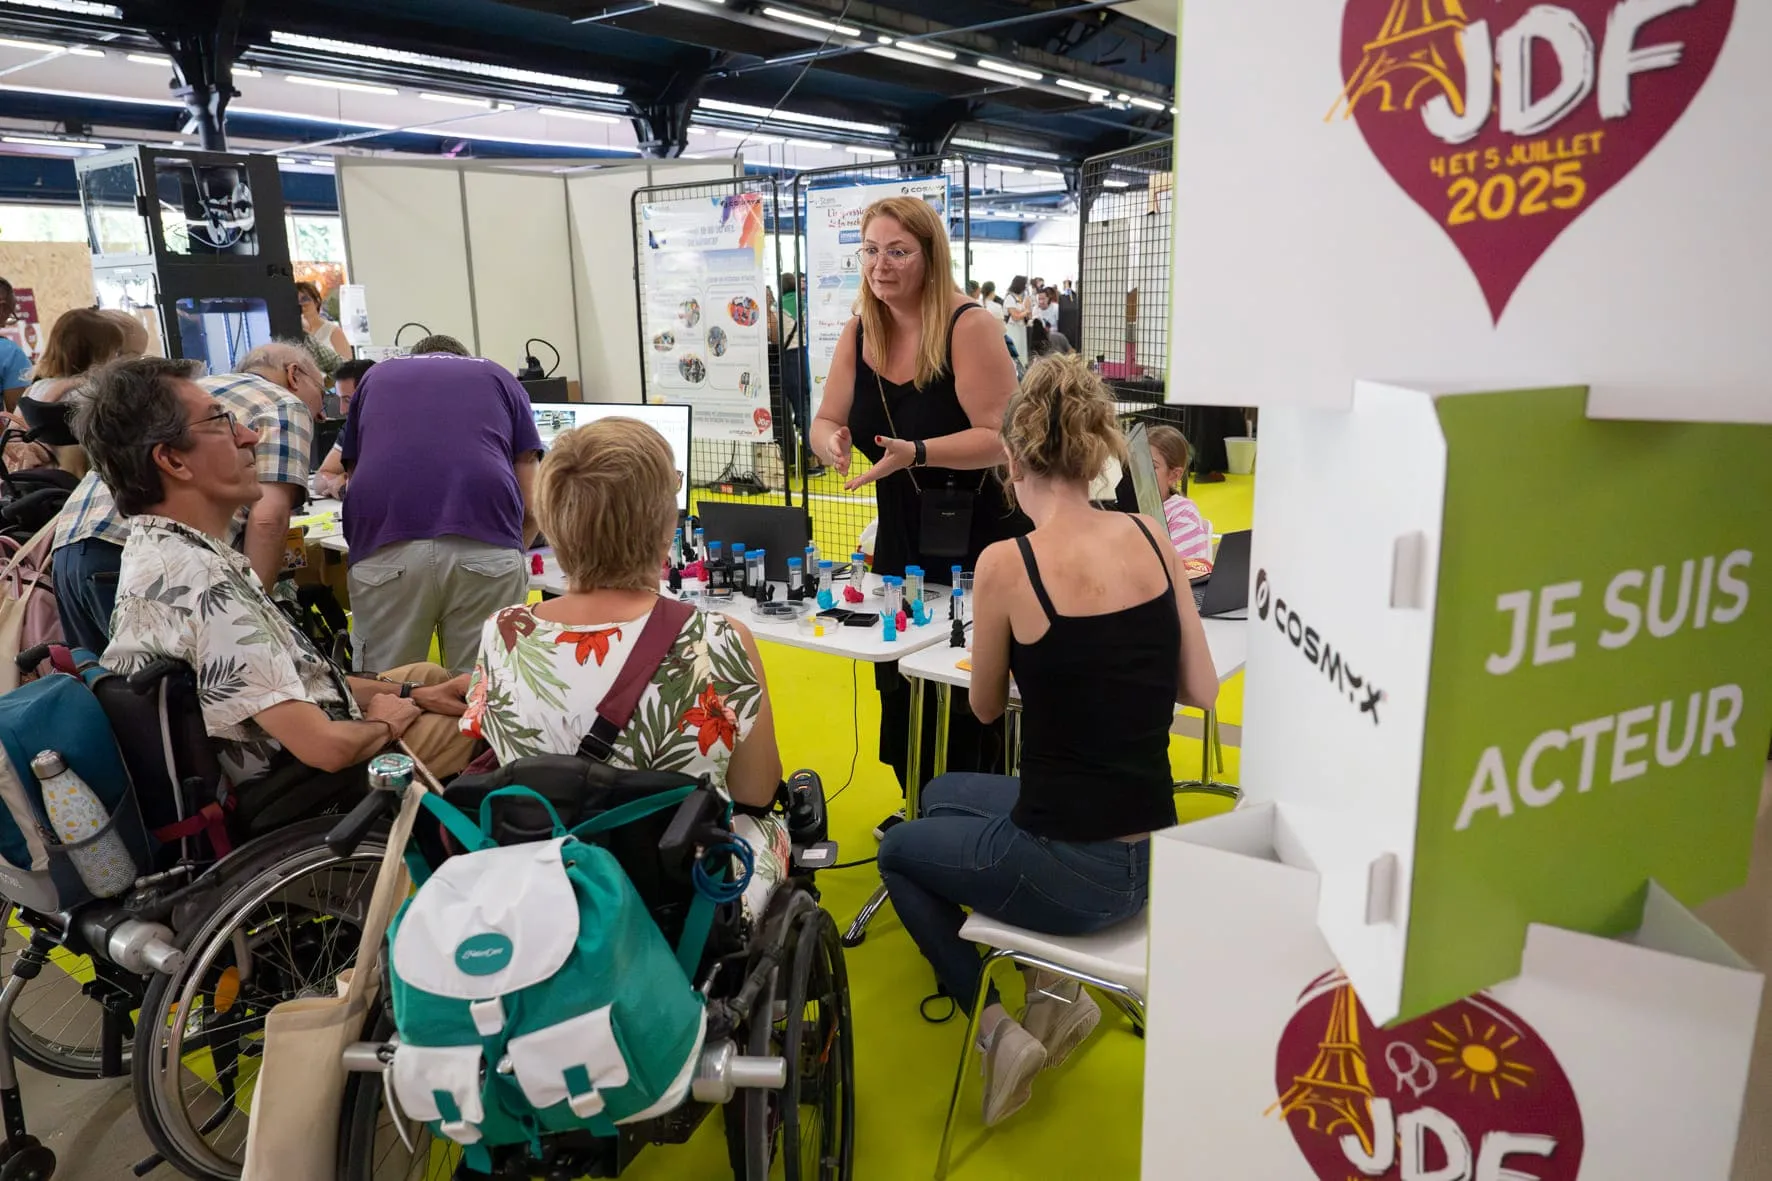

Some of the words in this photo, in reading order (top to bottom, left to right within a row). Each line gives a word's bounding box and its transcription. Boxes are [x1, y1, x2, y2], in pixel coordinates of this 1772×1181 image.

[1420, 0, 1697, 144] JDF
[1430, 156, 1446, 177] 4
[1449, 151, 1478, 175] ET
[1484, 147, 1500, 169] 5
[1505, 130, 1605, 167] JUILLET
[1447, 160, 1586, 225] 2025
[1274, 597, 1382, 726] COSMYX
[1484, 580, 1583, 675] JE
[1597, 548, 1752, 649] SUIS
[1453, 684, 1744, 831] ACTEUR
[1338, 1096, 1559, 1181] JDF
